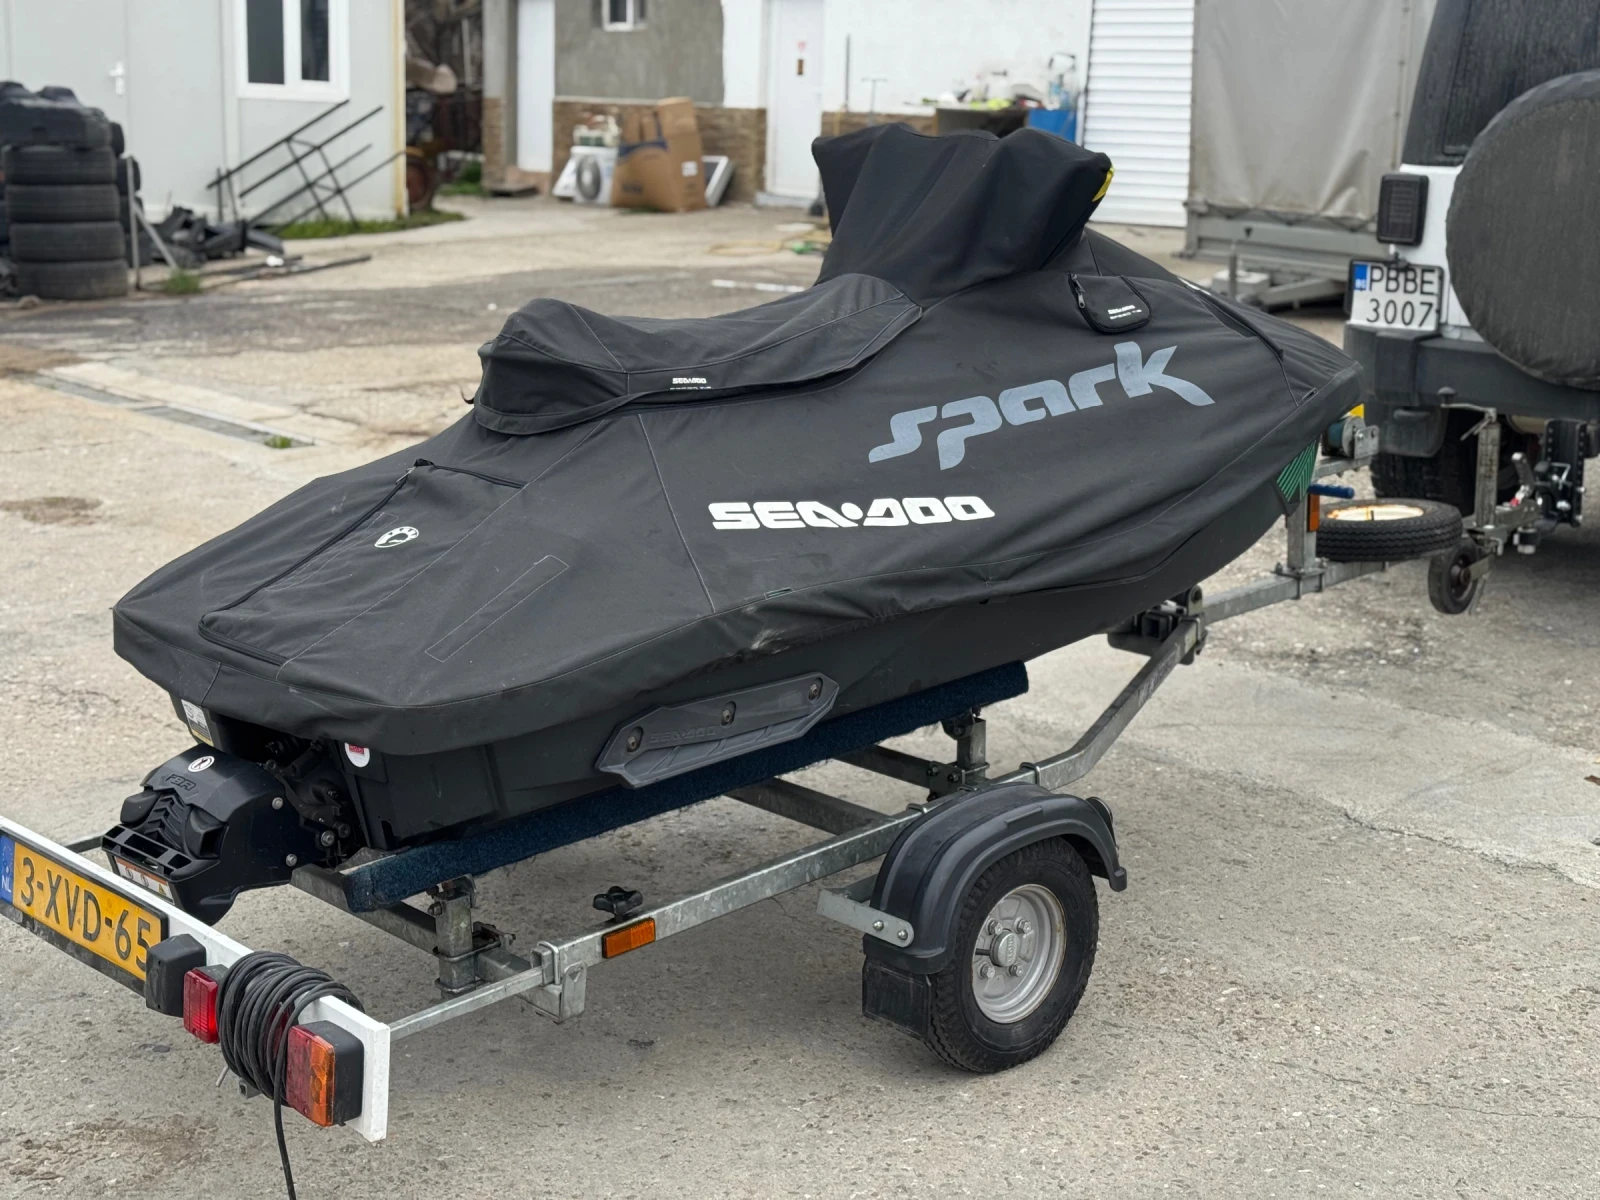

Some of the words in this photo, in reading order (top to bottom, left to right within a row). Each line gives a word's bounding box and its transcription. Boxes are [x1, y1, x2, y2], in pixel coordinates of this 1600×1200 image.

[1369, 265, 1436, 296] PBBE
[1366, 298, 1434, 328] 3007
[20, 856, 151, 973] 3-XVD-65
